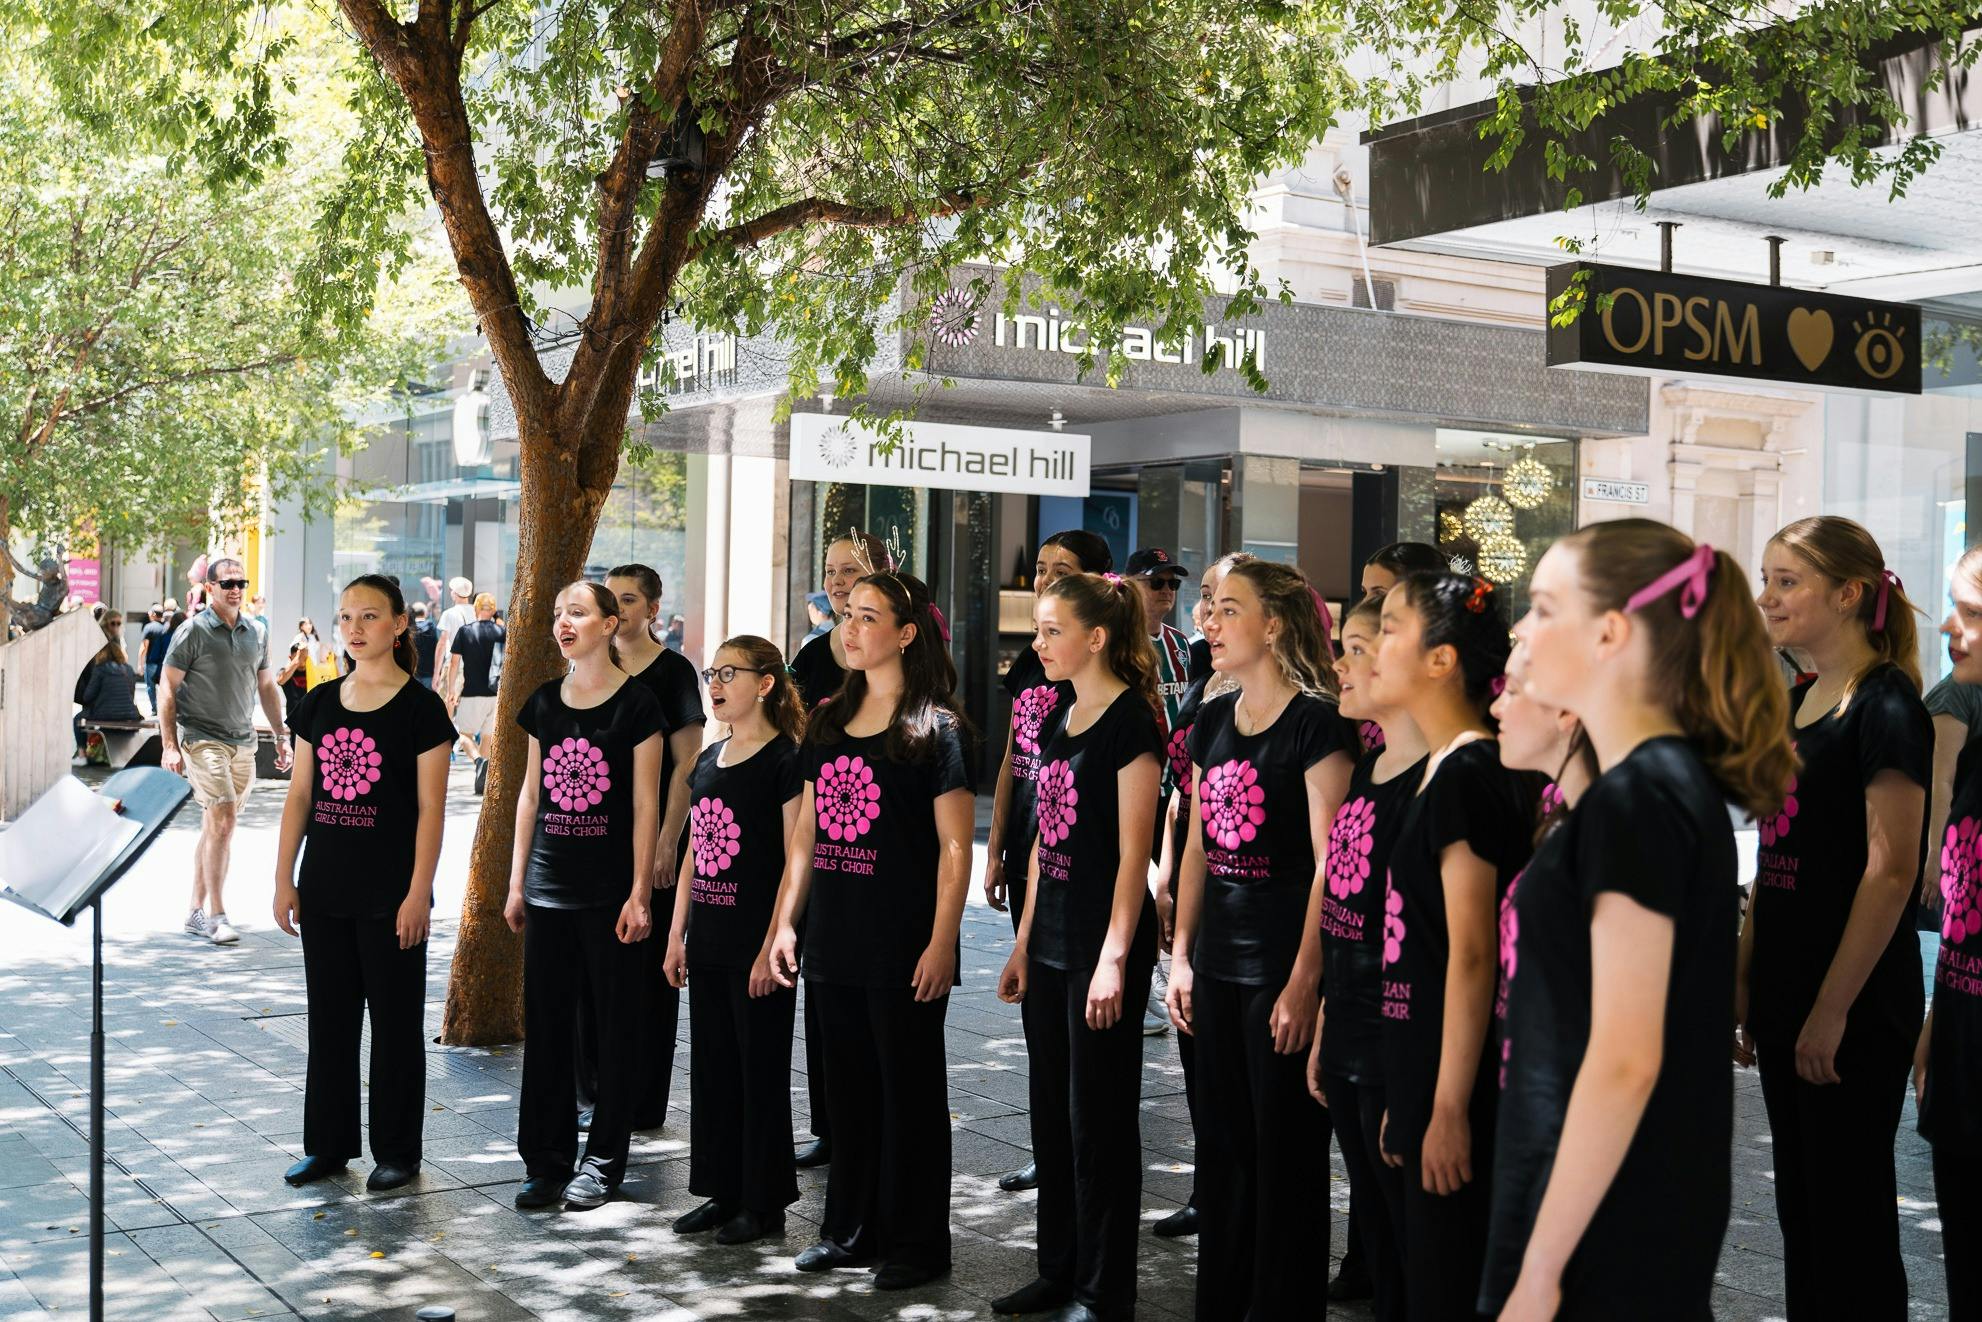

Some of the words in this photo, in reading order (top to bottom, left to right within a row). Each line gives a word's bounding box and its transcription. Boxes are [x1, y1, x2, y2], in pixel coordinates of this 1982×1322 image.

[1601, 287, 1762, 366] OPSM
[704, 333, 736, 374] hill
[1205, 325, 1265, 371] hill
[868, 439, 1017, 477] michael
[1030, 448, 1074, 481] hill
[1598, 483, 1632, 499] FRANCIS
[1636, 487, 1645, 500] ST
[1157, 681, 1189, 696] BETAN
[315, 801, 378, 816] AUSTRALIAN
[314, 812, 337, 825] GIRLS
[340, 816, 375, 827] CHOIR
[544, 812, 609, 825] AUSTRALIAN
[545, 824, 570, 836] GIRLS
[572, 826, 608, 837] CHOIR
[841, 860, 875, 876] CHOIR
[706, 893, 737, 906] CHOIR
